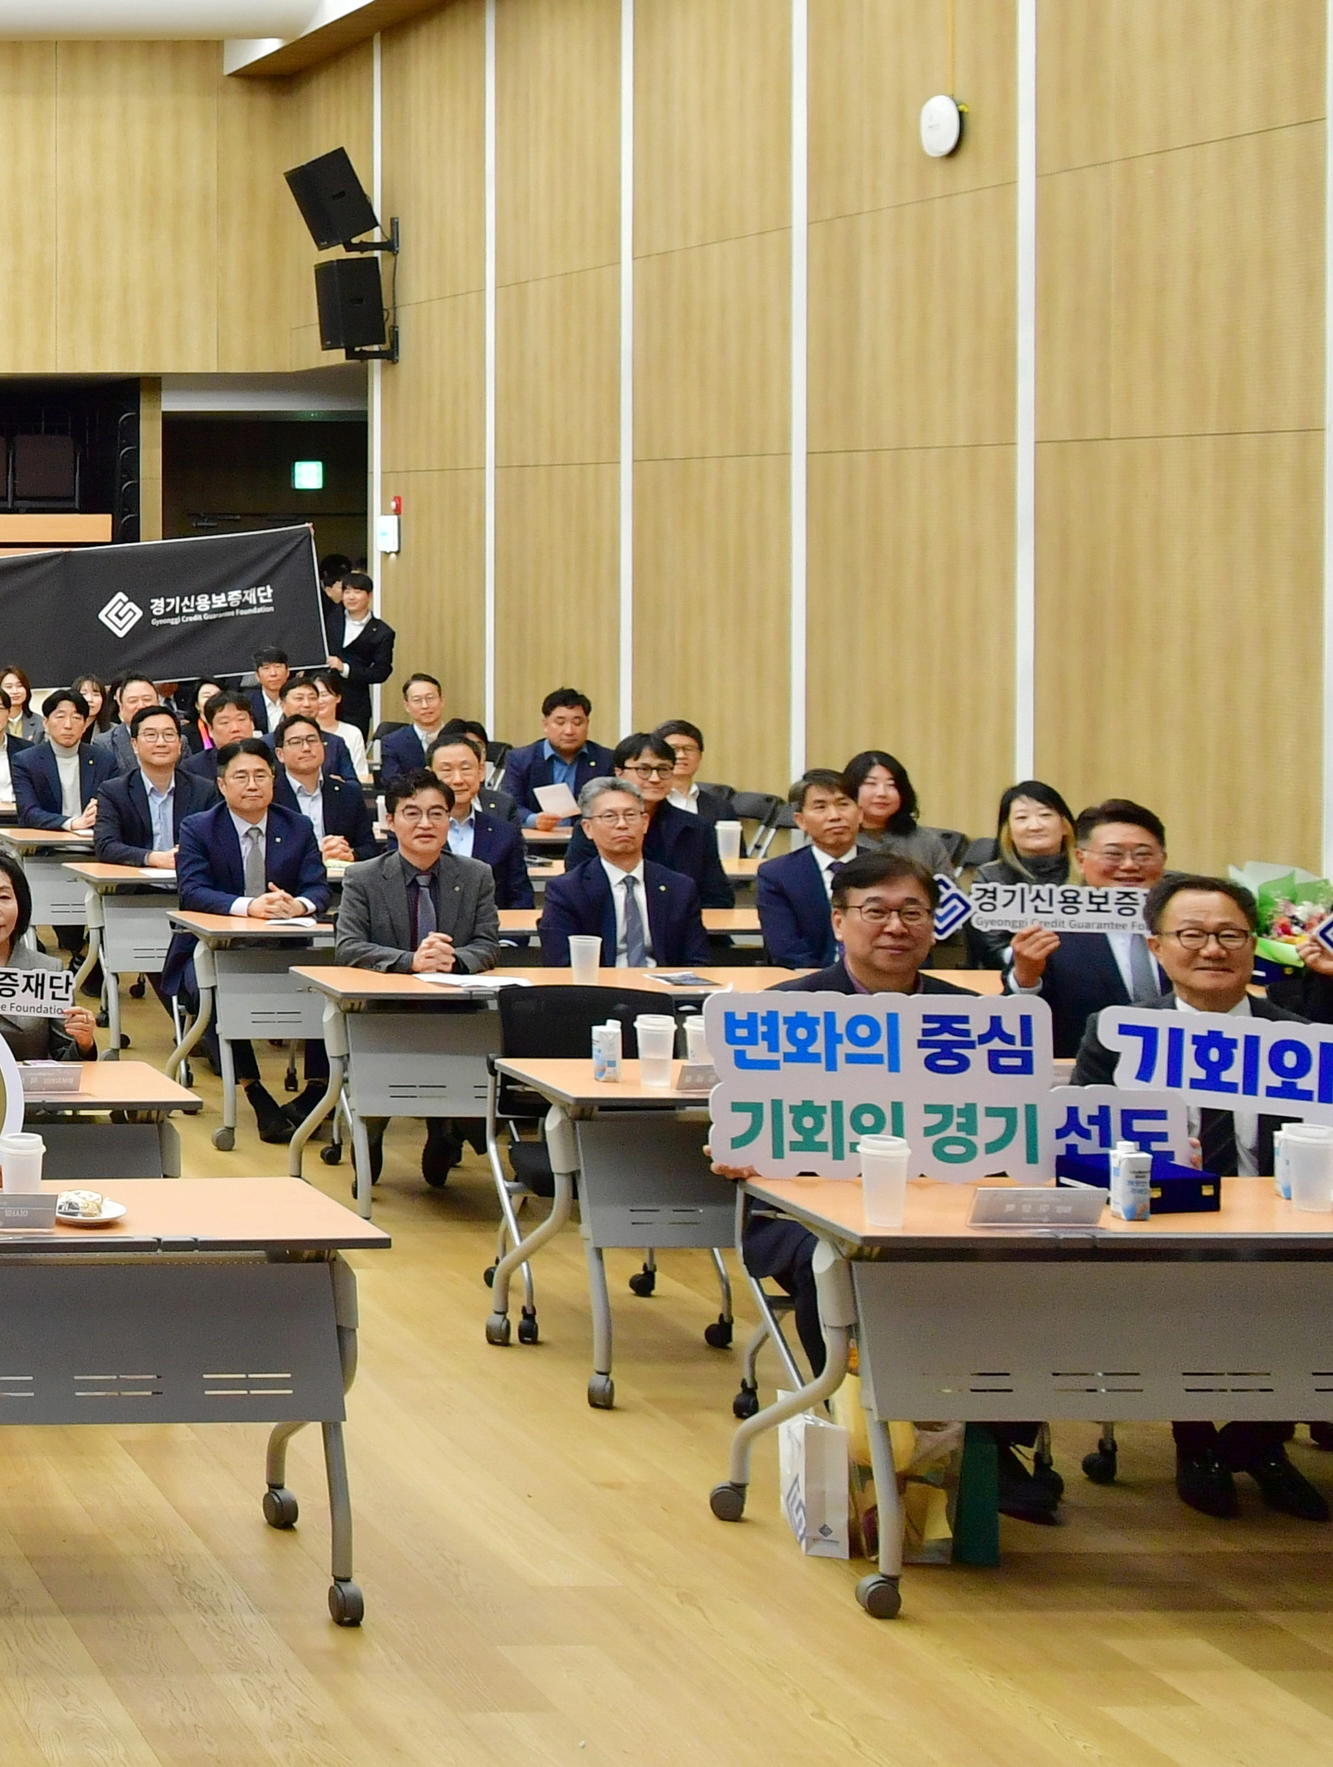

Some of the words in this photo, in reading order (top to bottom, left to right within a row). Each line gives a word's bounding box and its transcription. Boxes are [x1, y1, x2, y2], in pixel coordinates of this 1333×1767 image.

[149, 584, 274, 616] 경기신용보증재단
[151, 615, 181, 626] Gyeonggi
[181, 613, 203, 623] Credit
[236, 605, 275, 617] Foundation
[974, 886, 1141, 917] 경기신용보증
[976, 916, 1028, 929] Gyeonggi
[1069, 920, 1128, 931] Guarantee
[9, 1003, 66, 1016] Foundatio
[724, 1010, 901, 1073] 변화의
[916, 1013, 1035, 1076] 중심
[730, 1098, 904, 1162] 기회의
[923, 1102, 1040, 1165] 경기
